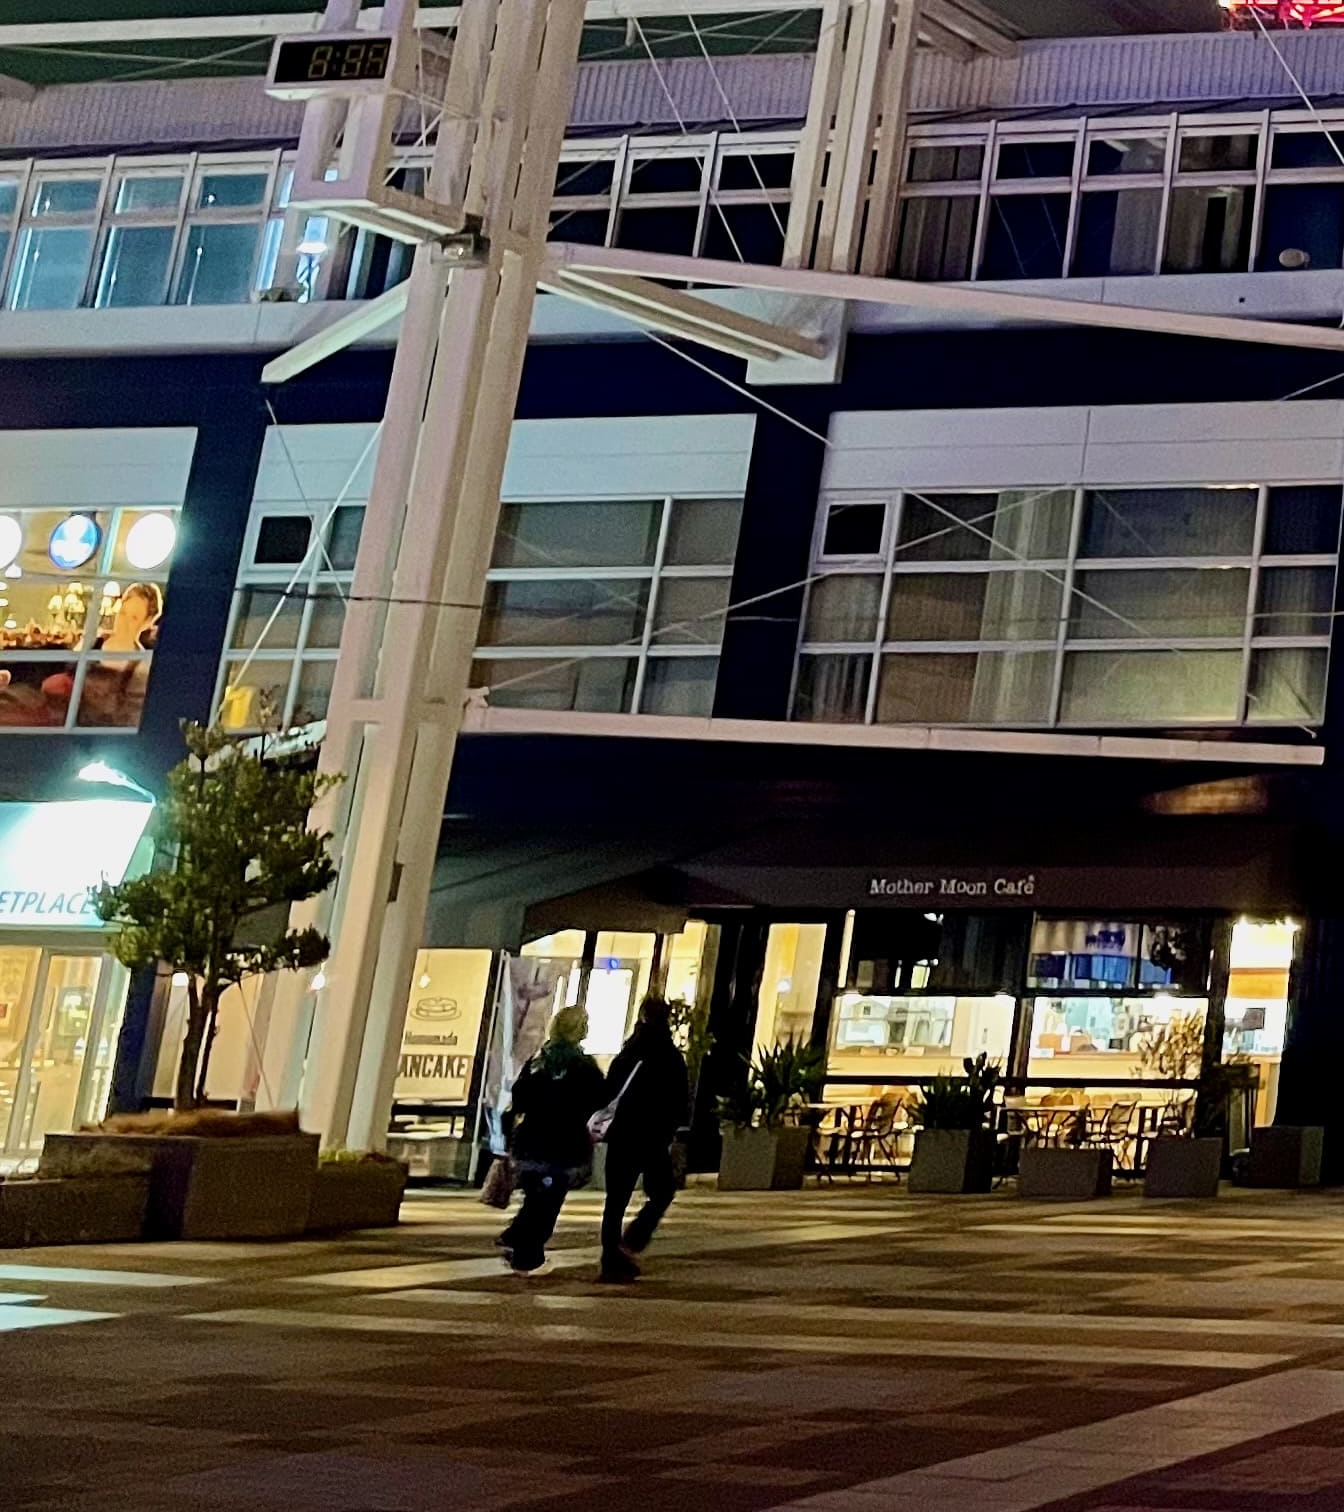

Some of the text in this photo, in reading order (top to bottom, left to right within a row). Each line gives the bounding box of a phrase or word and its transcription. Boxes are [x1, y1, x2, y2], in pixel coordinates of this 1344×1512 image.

[869, 874, 1035, 895] Mother Moon Café
[398, 1054, 469, 1078] ANCAKE
